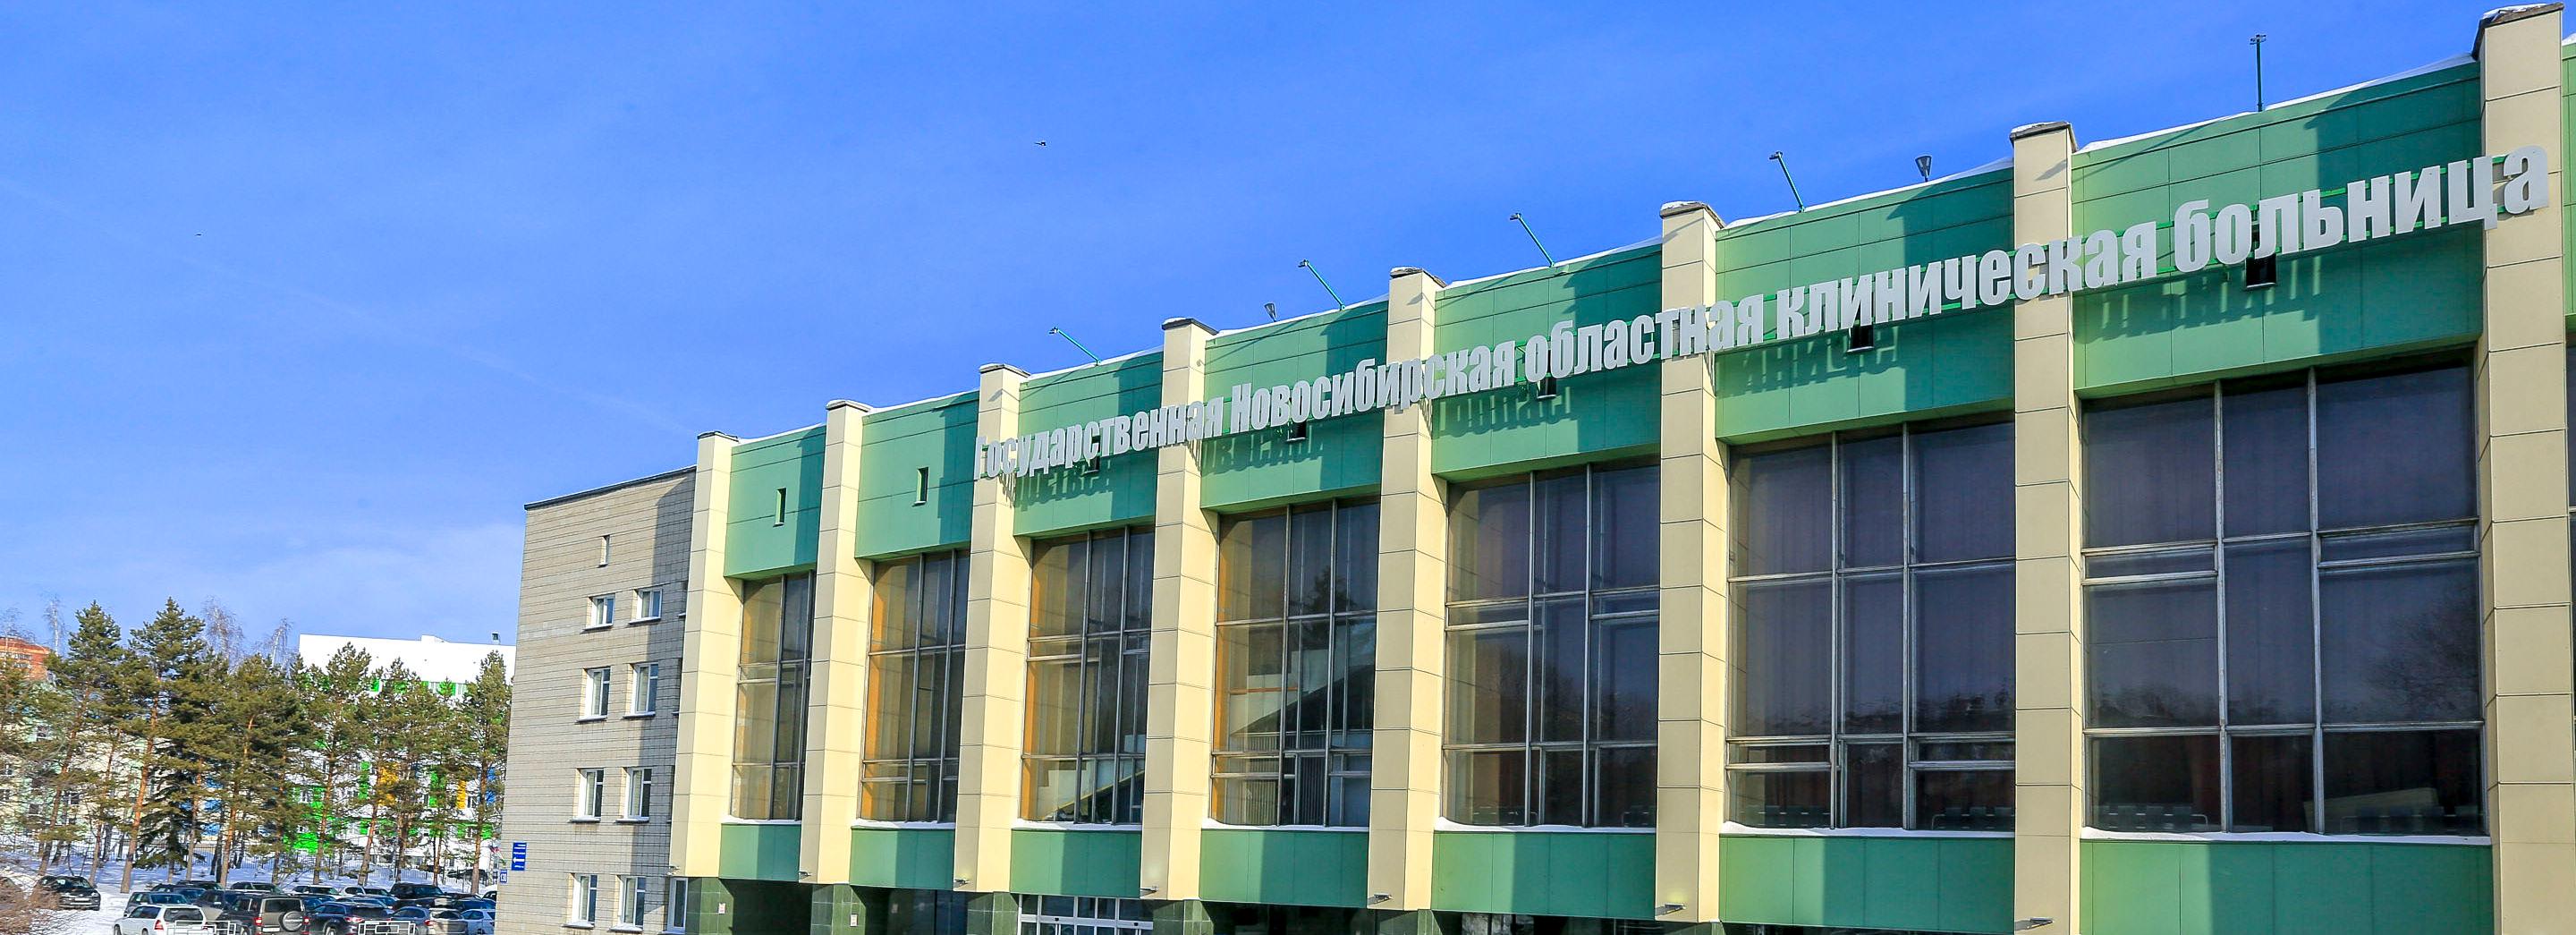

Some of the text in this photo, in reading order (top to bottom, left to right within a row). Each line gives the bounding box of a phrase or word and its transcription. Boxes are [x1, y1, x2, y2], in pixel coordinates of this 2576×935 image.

[974, 145, 2549, 480] Государственная Новосибирская областная клиническая больница
